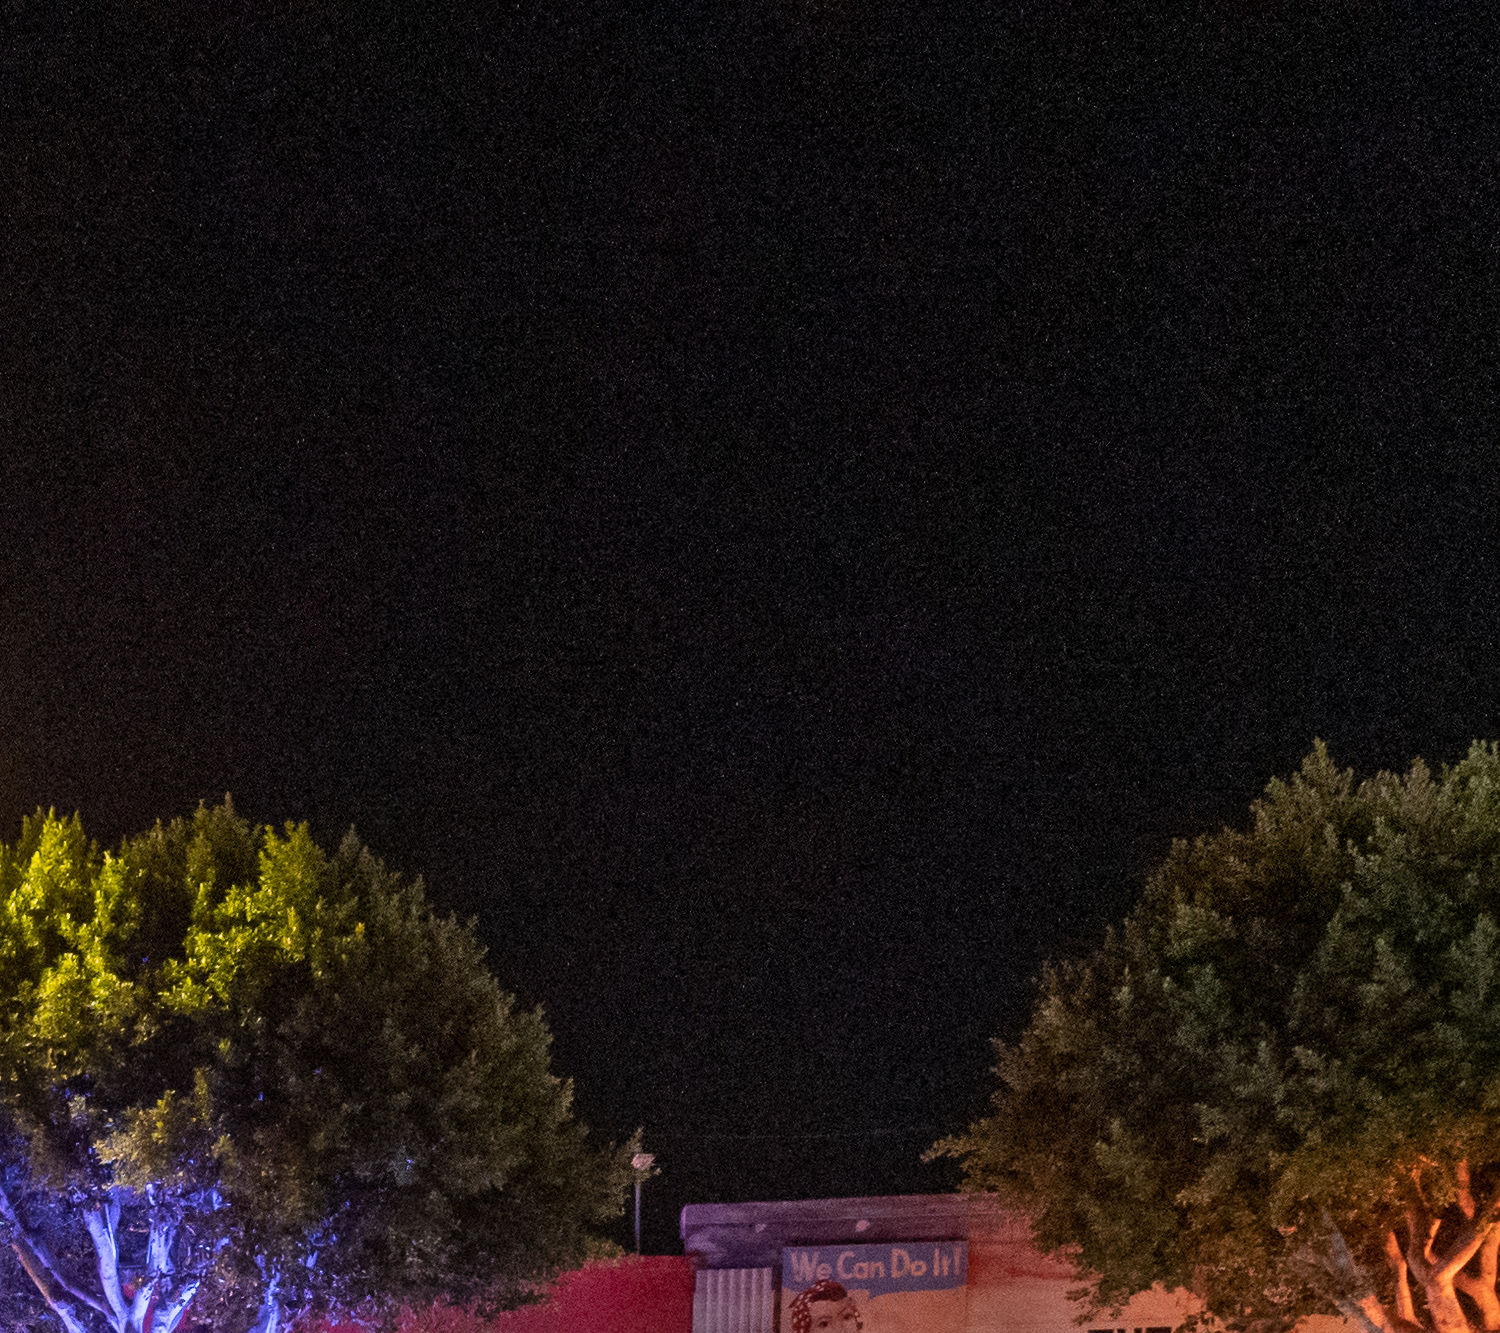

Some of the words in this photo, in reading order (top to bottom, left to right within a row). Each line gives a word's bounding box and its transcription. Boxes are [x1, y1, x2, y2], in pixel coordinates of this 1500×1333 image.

[791, 1251, 833, 1282] We
[836, 1251, 885, 1280] Can
[891, 1248, 928, 1279] Do
